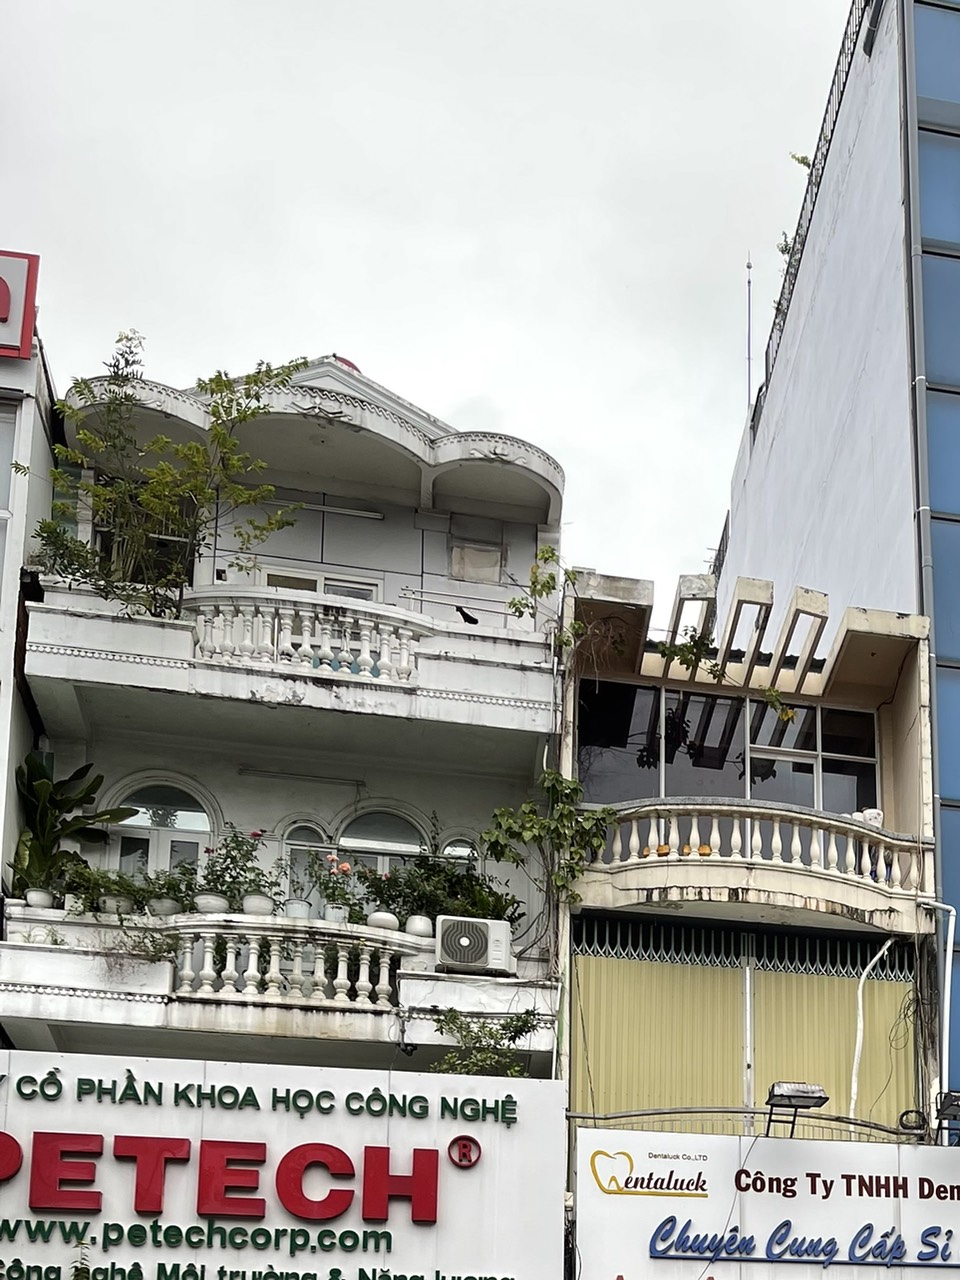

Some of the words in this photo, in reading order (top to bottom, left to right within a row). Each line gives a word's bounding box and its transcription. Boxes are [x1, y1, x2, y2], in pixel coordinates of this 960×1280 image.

[16, 1066, 62, 1101] CỔ
[77, 1068, 163, 1106] PHẦN
[174, 1083, 260, 1110] KHOA
[271, 1088, 335, 1119] HỌC
[345, 1087, 429, 1118] CÔNG
[441, 1094, 518, 1128] NGHỆ
[648, 1152, 680, 1160] Dentaluck
[734, 1168, 798, 1198] Công
[805, 1173, 835, 1200] Ty
[841, 1174, 908, 1199] TNHH
[0, 1218, 392, 1257] www.petechcorp.com
[650, 1215, 756, 1263] Chuyên
[766, 1219, 839, 1268] Cung
[849, 1223, 907, 1268] Cấp
[917, 1226, 954, 1262] Sỉ
